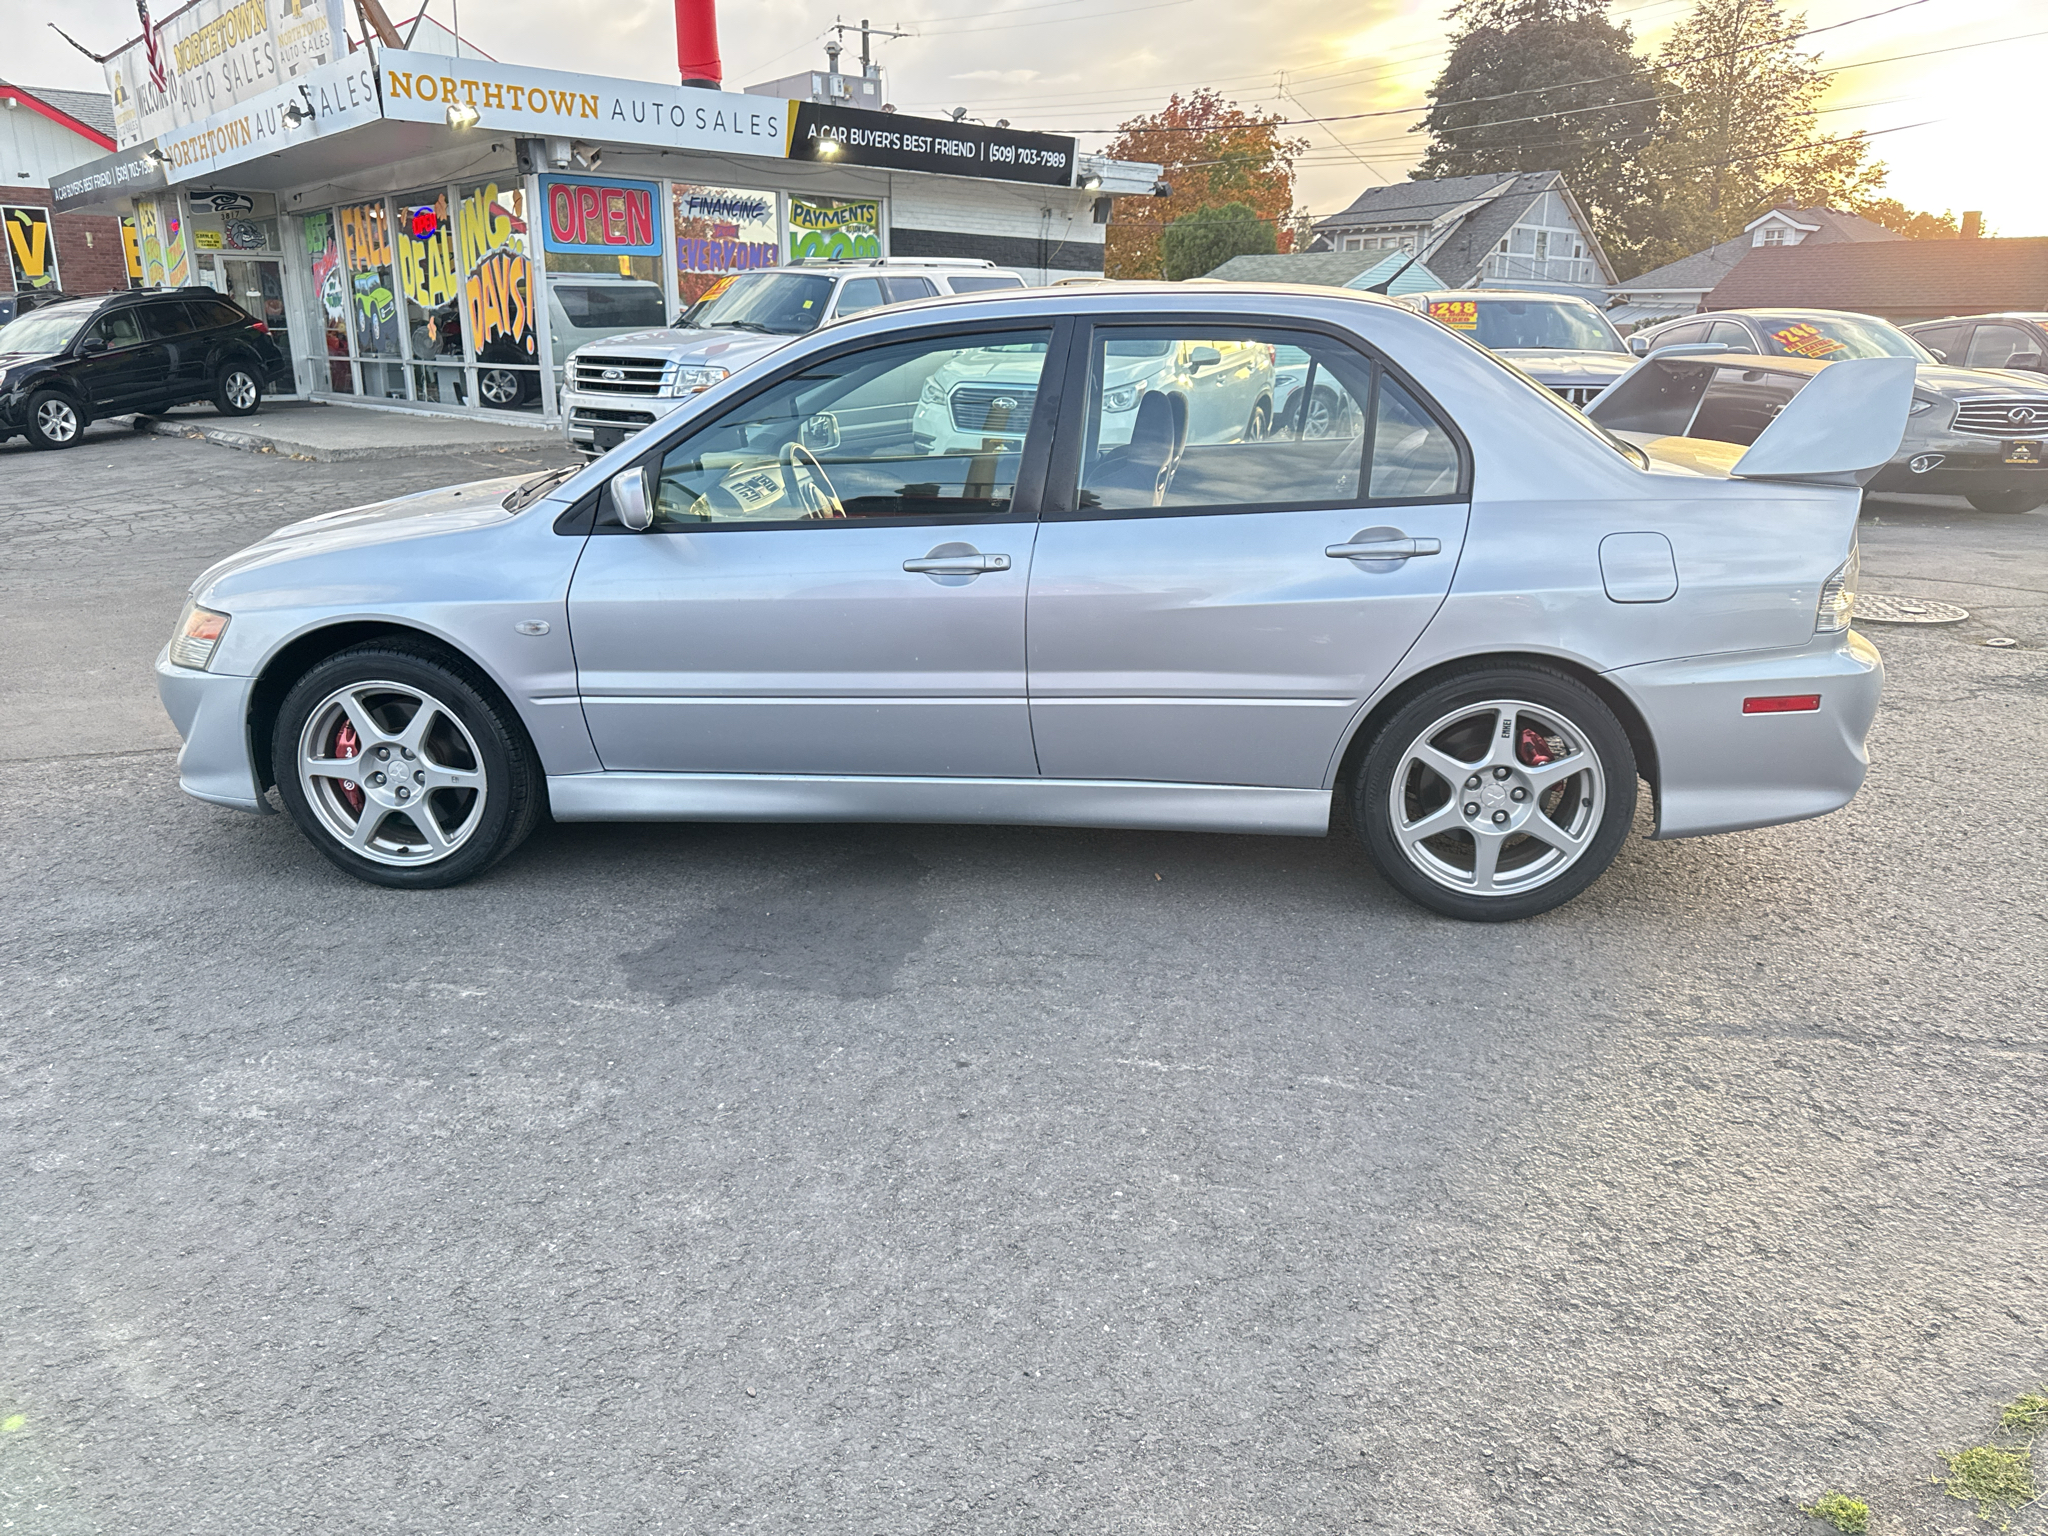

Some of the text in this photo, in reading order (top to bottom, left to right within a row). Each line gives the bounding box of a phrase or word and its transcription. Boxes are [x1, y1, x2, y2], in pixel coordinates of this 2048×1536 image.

[173, 0, 267, 77] NORTHTOWN
[277, 15, 328, 48] NORTHTOWN
[280, 32, 330, 64] AUTO SALES
[180, 41, 275, 112] AUTO SALES
[165, 69, 373, 171] NORTHTOWN AUT ALES
[388, 70, 778, 138] NORTHTOWN AUTO SALES
[807, 123, 817, 139] A
[820, 125, 847, 144] CAR
[850, 128, 900, 150] BUYER'S
[903, 134, 932, 154] BEST
[935, 138, 976, 158] FRIEND
[989, 143, 1015, 165] (509)
[1017, 147, 1066, 168] 703-7989
[220, 210, 241, 221] 3817
[412, 212, 437, 235] OPEN
[549, 184, 653, 246] OPEN
[688, 196, 764, 218] FINANCING
[793, 203, 875, 227] PAYMENTS
[341, 202, 392, 272] FALL
[677, 236, 779, 272] EVERYONE!
[466, 253, 535, 356] DAYS!
[1430, 301, 1476, 314] $248
[1770, 323, 1819, 344] $246
